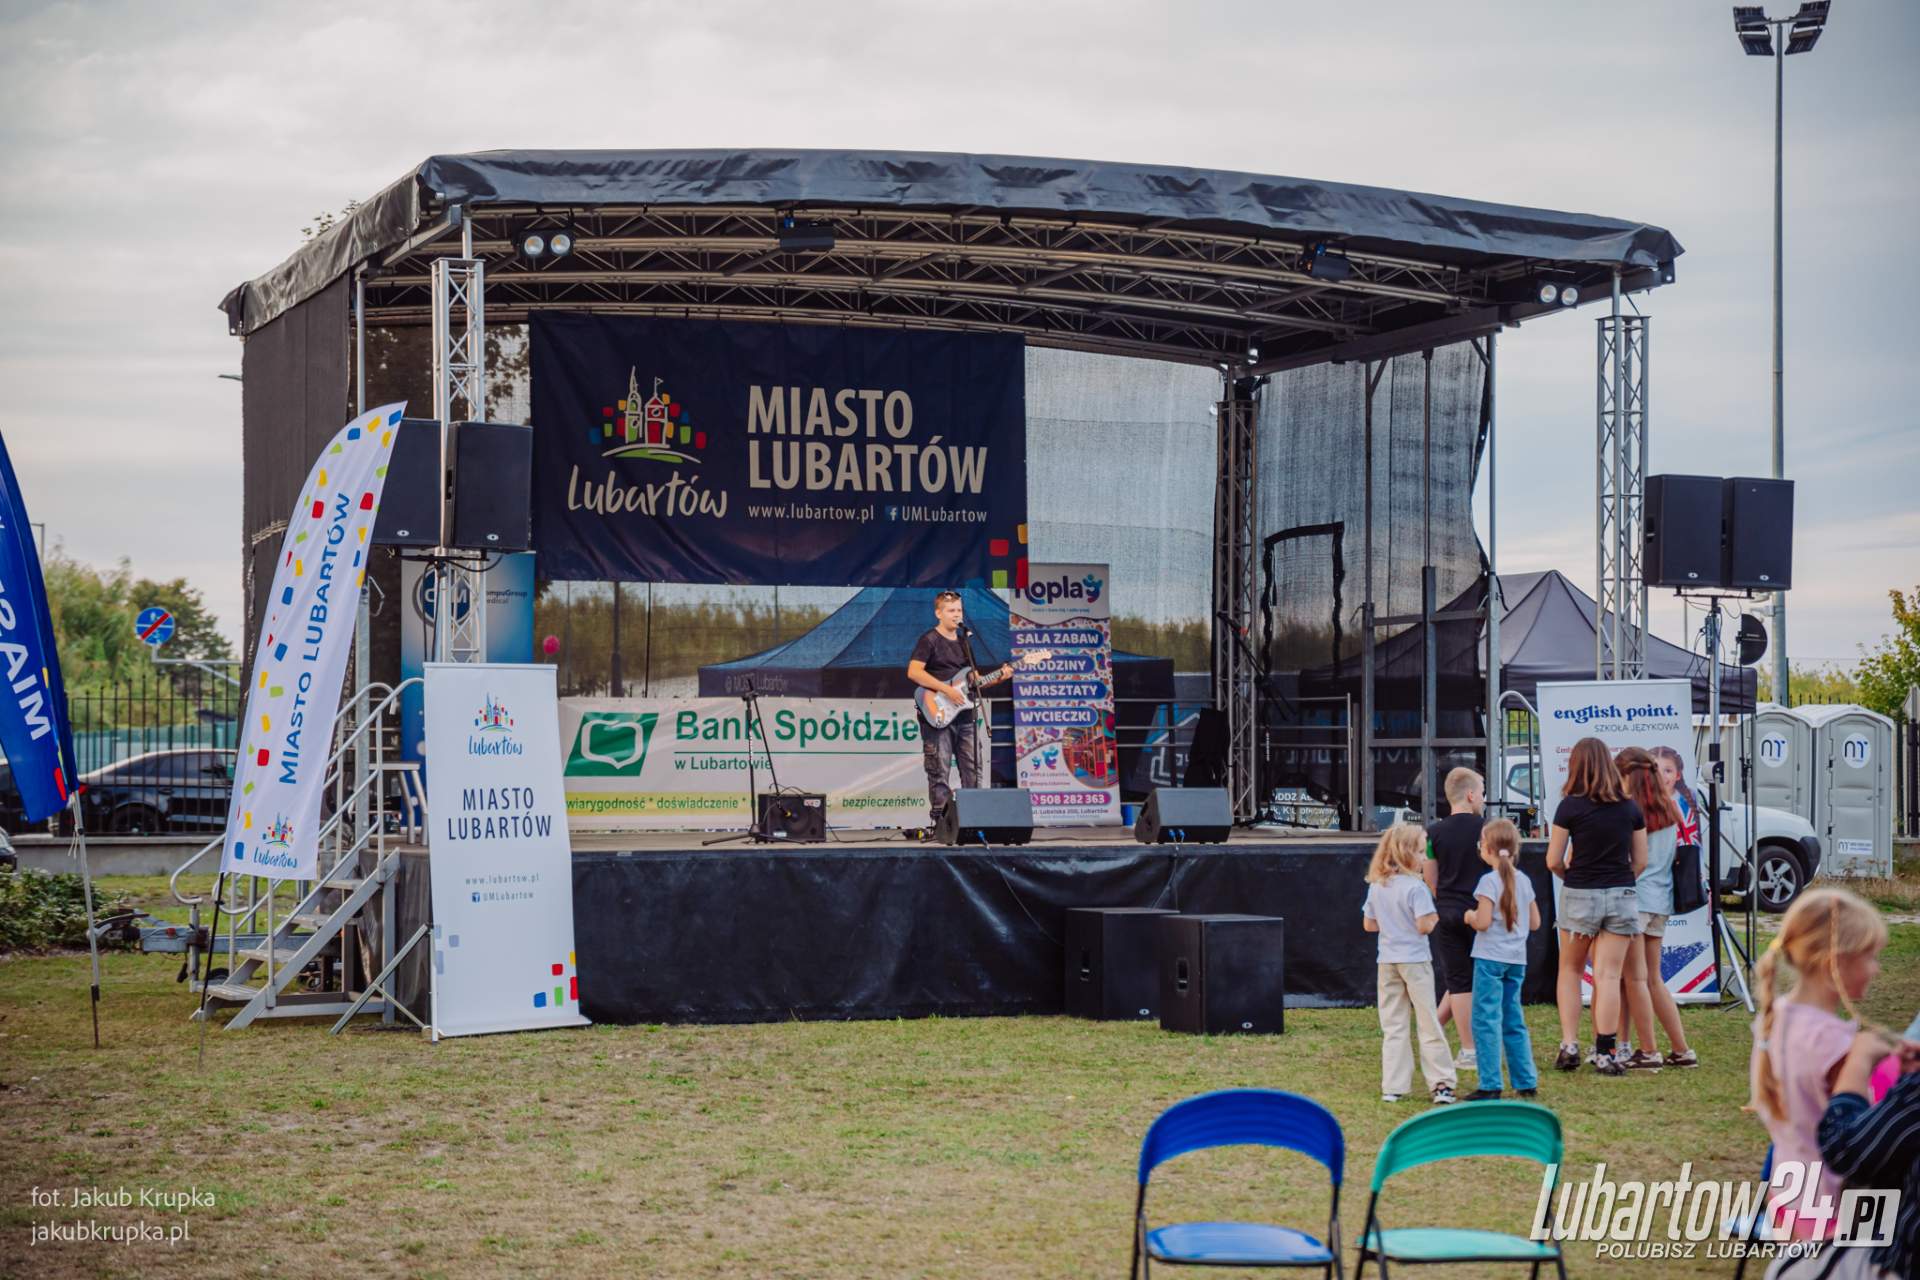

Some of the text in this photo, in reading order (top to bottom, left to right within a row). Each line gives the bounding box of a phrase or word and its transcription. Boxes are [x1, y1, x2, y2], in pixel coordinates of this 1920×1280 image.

[747, 385, 914, 439] MIASTO
[748, 435, 988, 494] LUBARTÓW
[567, 464, 728, 518] Lubartów
[748, 503, 874, 524] www.lubartow.pl
[902, 505, 987, 523] UMLubartow
[278, 492, 351, 785] MIASTO LUBARTÓW
[1016, 632, 1099, 645] SALA ZABAW
[1019, 685, 1098, 696] WARSZTATY
[1020, 711, 1091, 722] WYCIECZKI
[1554, 703, 1678, 723] english point.
[676, 710, 762, 741] Bank
[1631, 722, 1680, 733] JĘZYKOWA
[468, 735, 523, 756] Lubartów
[675, 756, 772, 771] w Lubartowie
[462, 787, 534, 811] MIASTO
[566, 796, 646, 813] wiarygodność
[656, 796, 739, 810] doświadczenie
[842, 796, 926, 809] bezpieczeństwo
[1040, 793, 1105, 805] 508 282 363
[448, 812, 551, 840] LUBARTÓW
[253, 846, 298, 869] Lubartów
[465, 872, 540, 886] www.lubartow.pl
